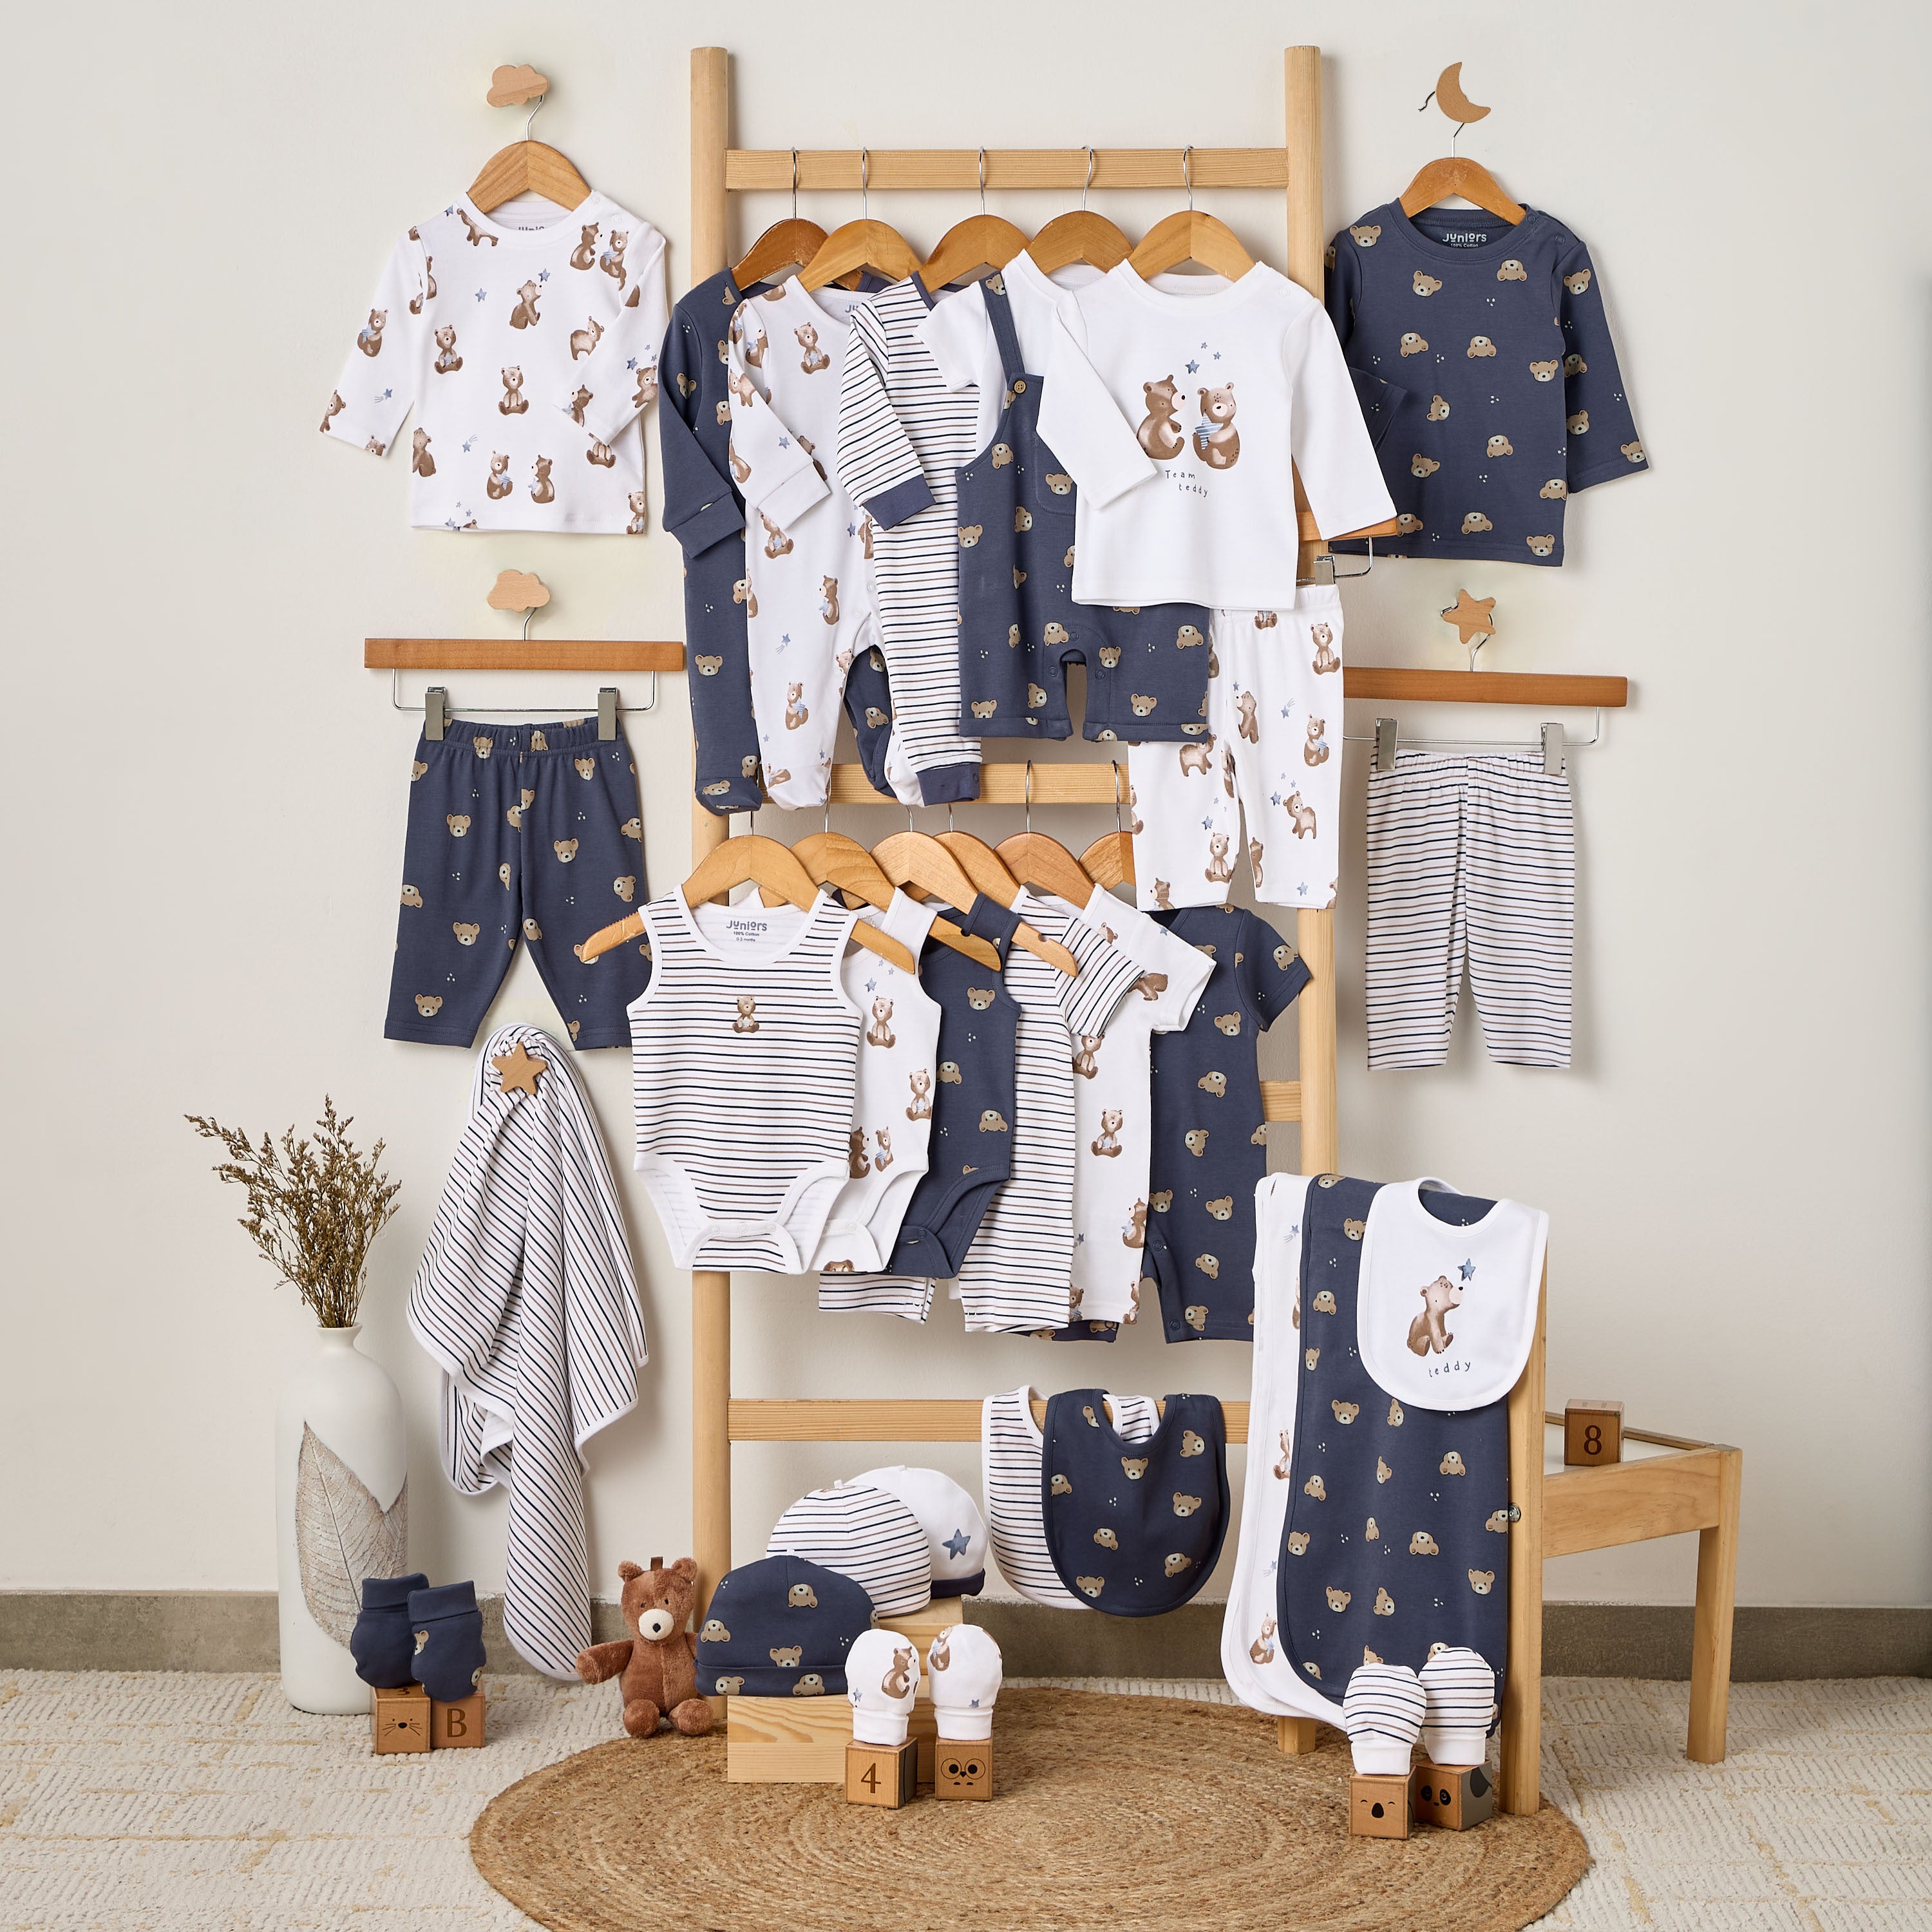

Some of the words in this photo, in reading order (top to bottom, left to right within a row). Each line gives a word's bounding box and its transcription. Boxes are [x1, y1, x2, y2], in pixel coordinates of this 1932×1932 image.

[1442, 232, 1487, 243] Juniors
[1165, 469, 1195, 480] Team
[1179, 483, 1208, 498] teddy
[726, 920, 768, 932] Juniors
[1428, 1360, 1471, 1378] teddy
[1584, 1425, 1602, 1455] 8
[447, 1708, 468, 1738] B
[860, 1762, 882, 1794] 4
